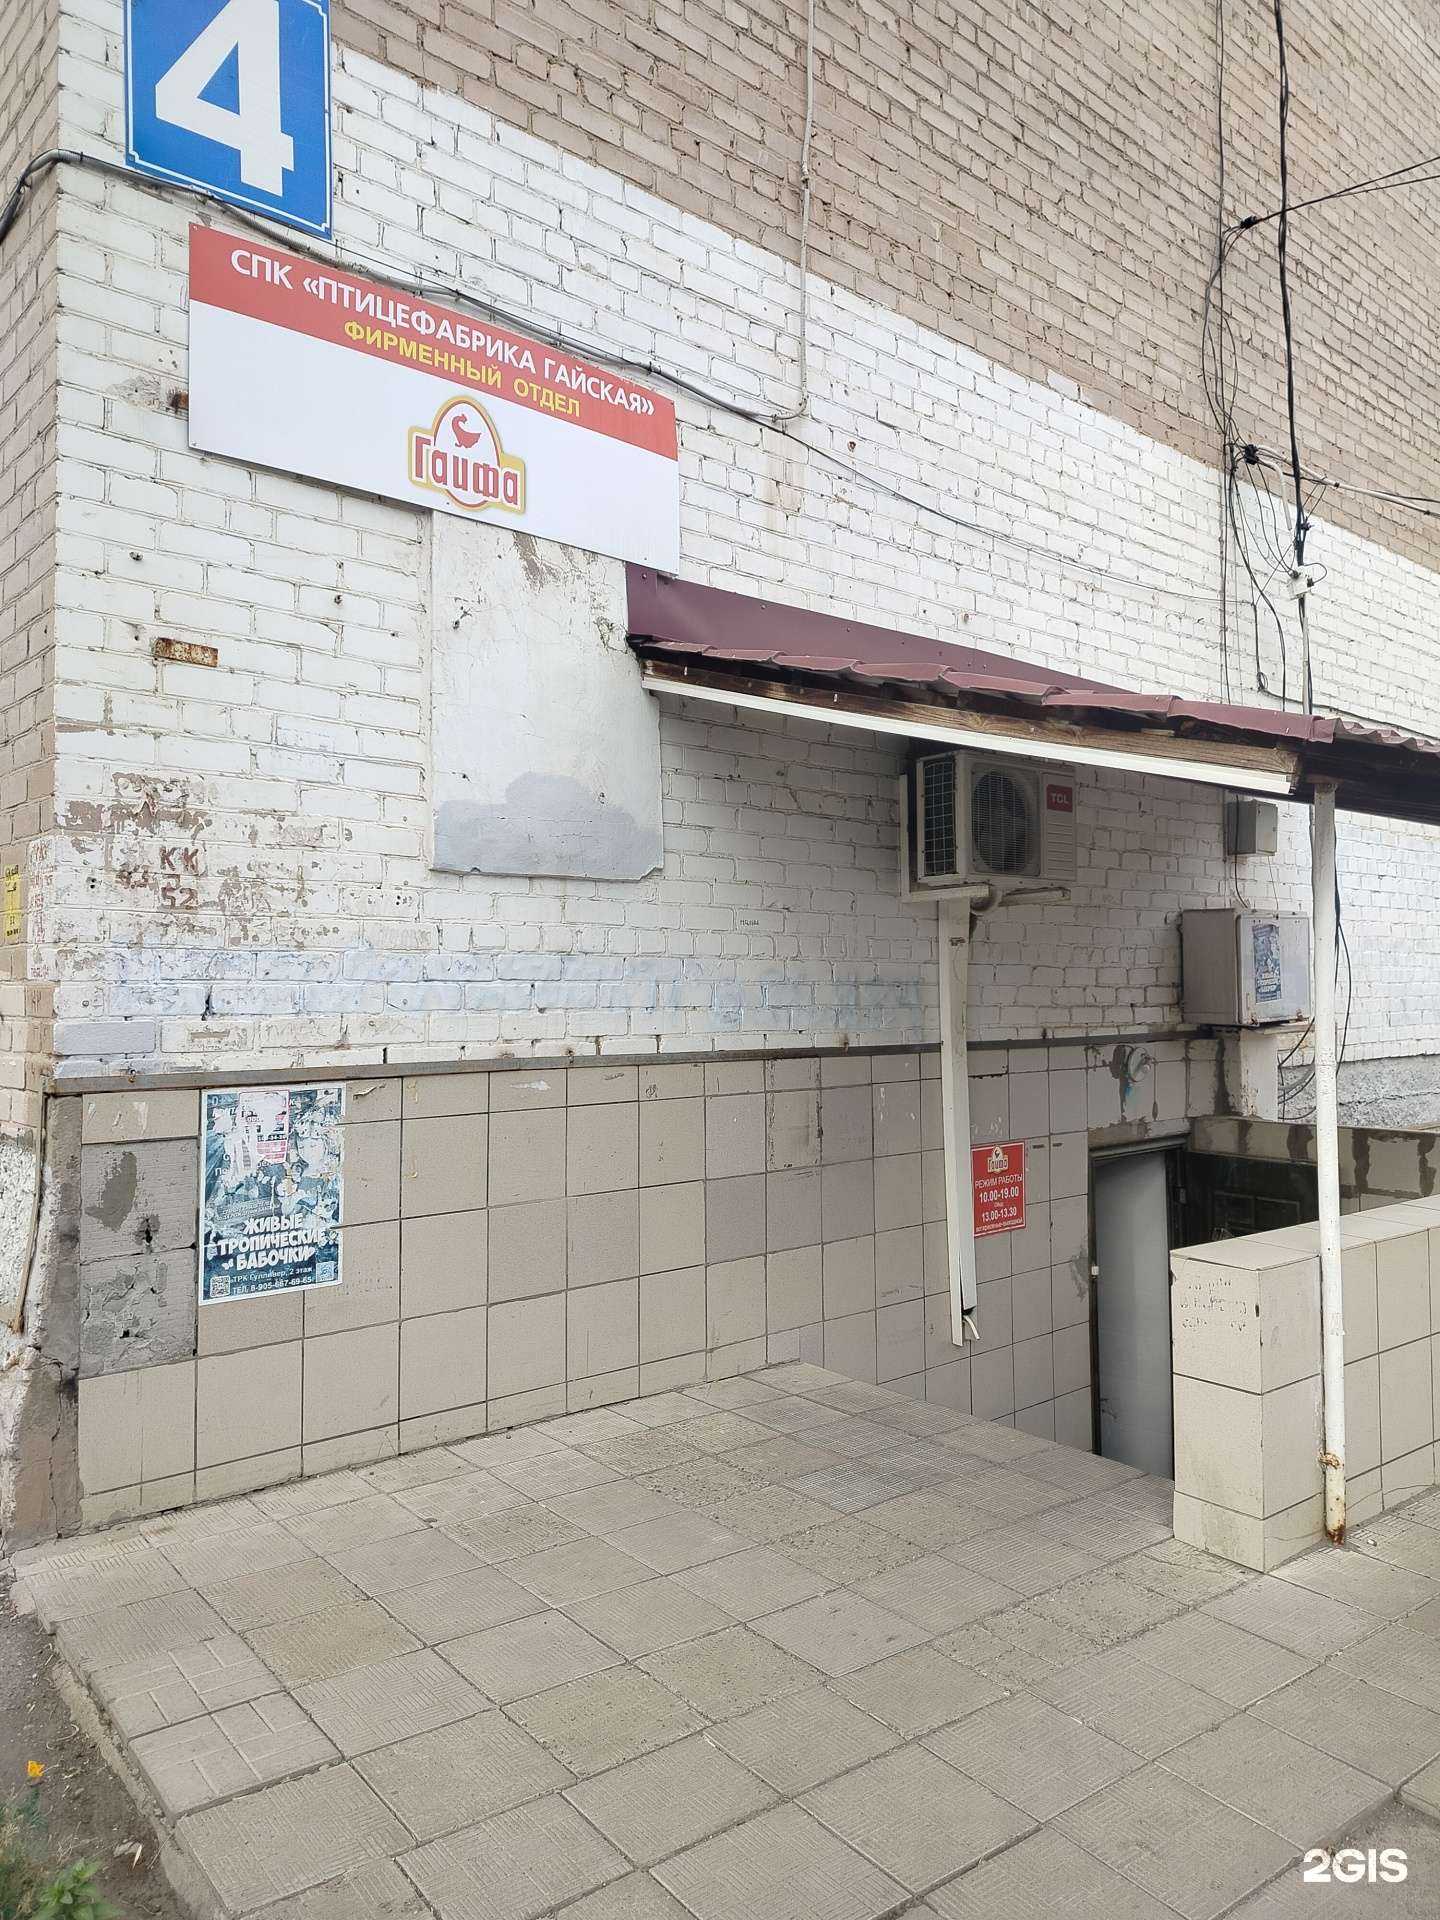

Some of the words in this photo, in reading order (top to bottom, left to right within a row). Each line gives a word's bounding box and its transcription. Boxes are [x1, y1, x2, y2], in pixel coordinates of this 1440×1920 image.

[154, 0, 295, 197] 4
[230, 249, 294, 290] СПК
[301, 275, 537, 375] «ПТИЦЕФАБРИКА
[543, 356, 656, 417] ГАЙСКАЯ»
[343, 320, 503, 389] ФИРМЕННЫЙ
[512, 378, 581, 418] ОТДЕЛ
[1051, 793, 1069, 804] TCL
[975, 1177, 998, 1188] РЕЖИМ
[998, 1174, 1023, 1185] РАБОТЫ
[979, 1186, 1019, 1203] 10.00-19.00
[243, 1213, 304, 1235] ЖИВЫЕ
[982, 1206, 1017, 1222] 13.00-13.30
[217, 1227, 326, 1256] ТРОПИЧЕСКИЕ
[236, 1245, 314, 1271] БАБОЧКИ
